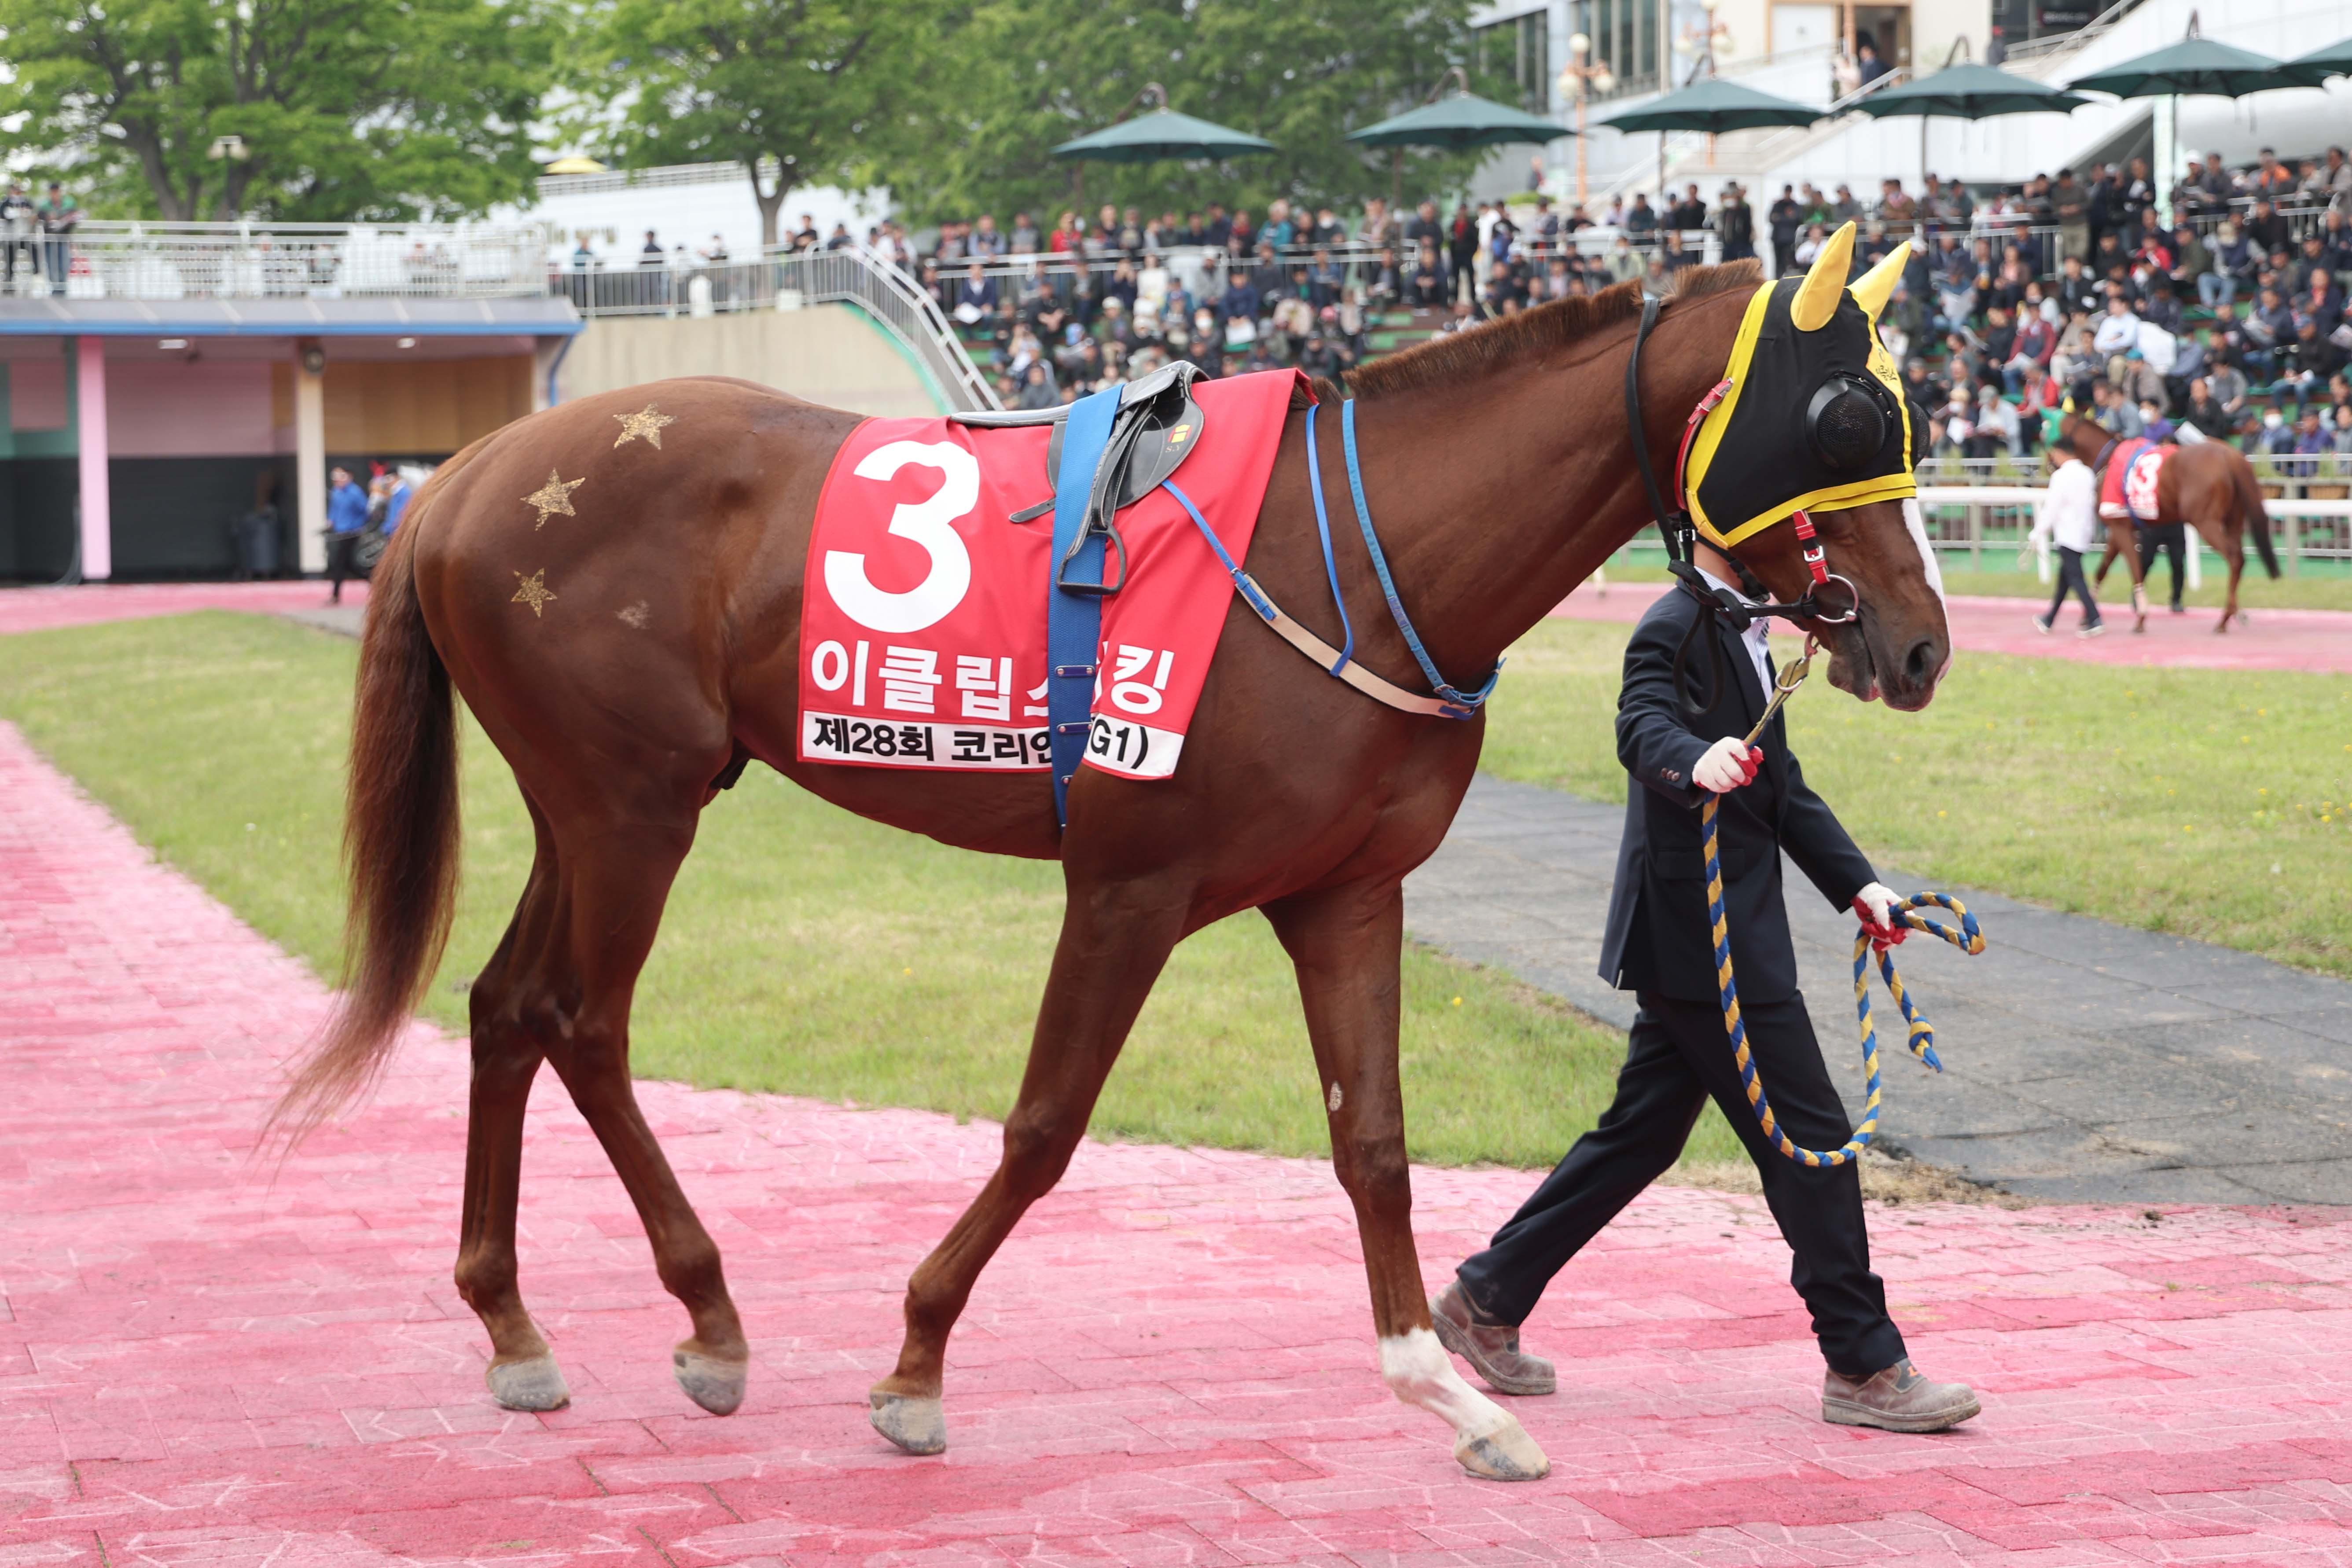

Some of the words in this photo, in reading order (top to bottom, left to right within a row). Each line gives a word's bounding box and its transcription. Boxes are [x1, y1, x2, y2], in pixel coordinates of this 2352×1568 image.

[824, 440, 981, 633] 3
[813, 718, 934, 762] 제28회
[1085, 719, 1148, 769] G1)
